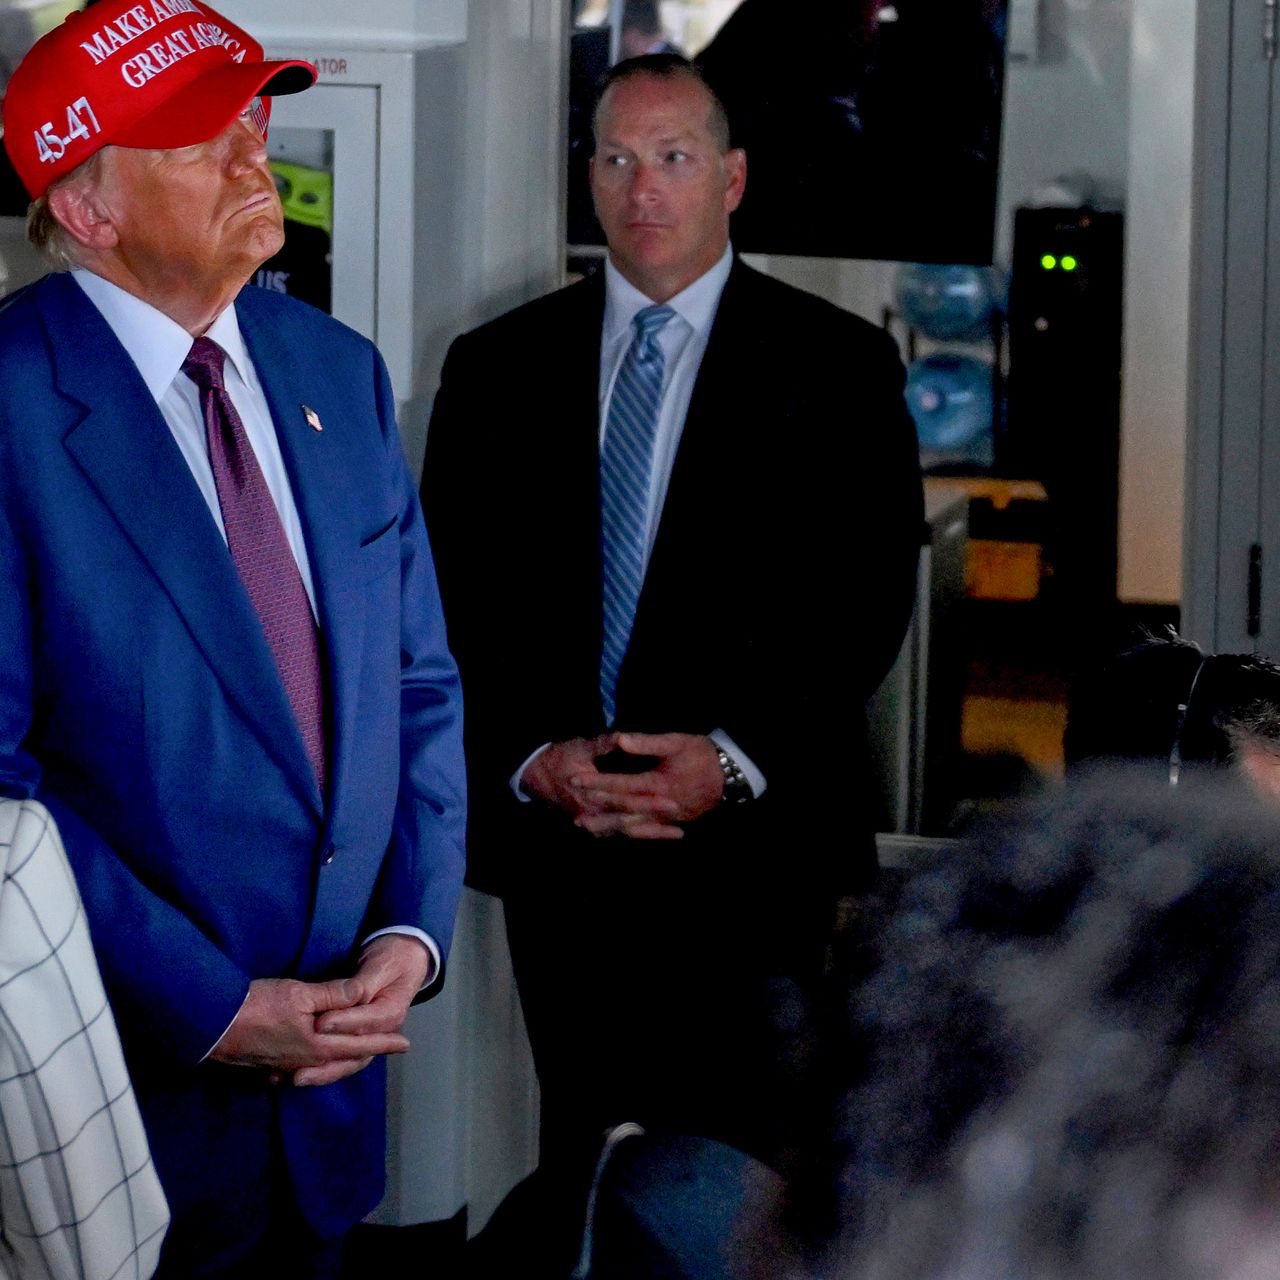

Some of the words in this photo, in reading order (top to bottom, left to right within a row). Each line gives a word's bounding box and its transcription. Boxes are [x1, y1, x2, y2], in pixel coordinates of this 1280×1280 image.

[80, 4, 157, 65] MAKE
[121, 29, 197, 89] GREAT
[33, 96, 103, 165] 45-47
